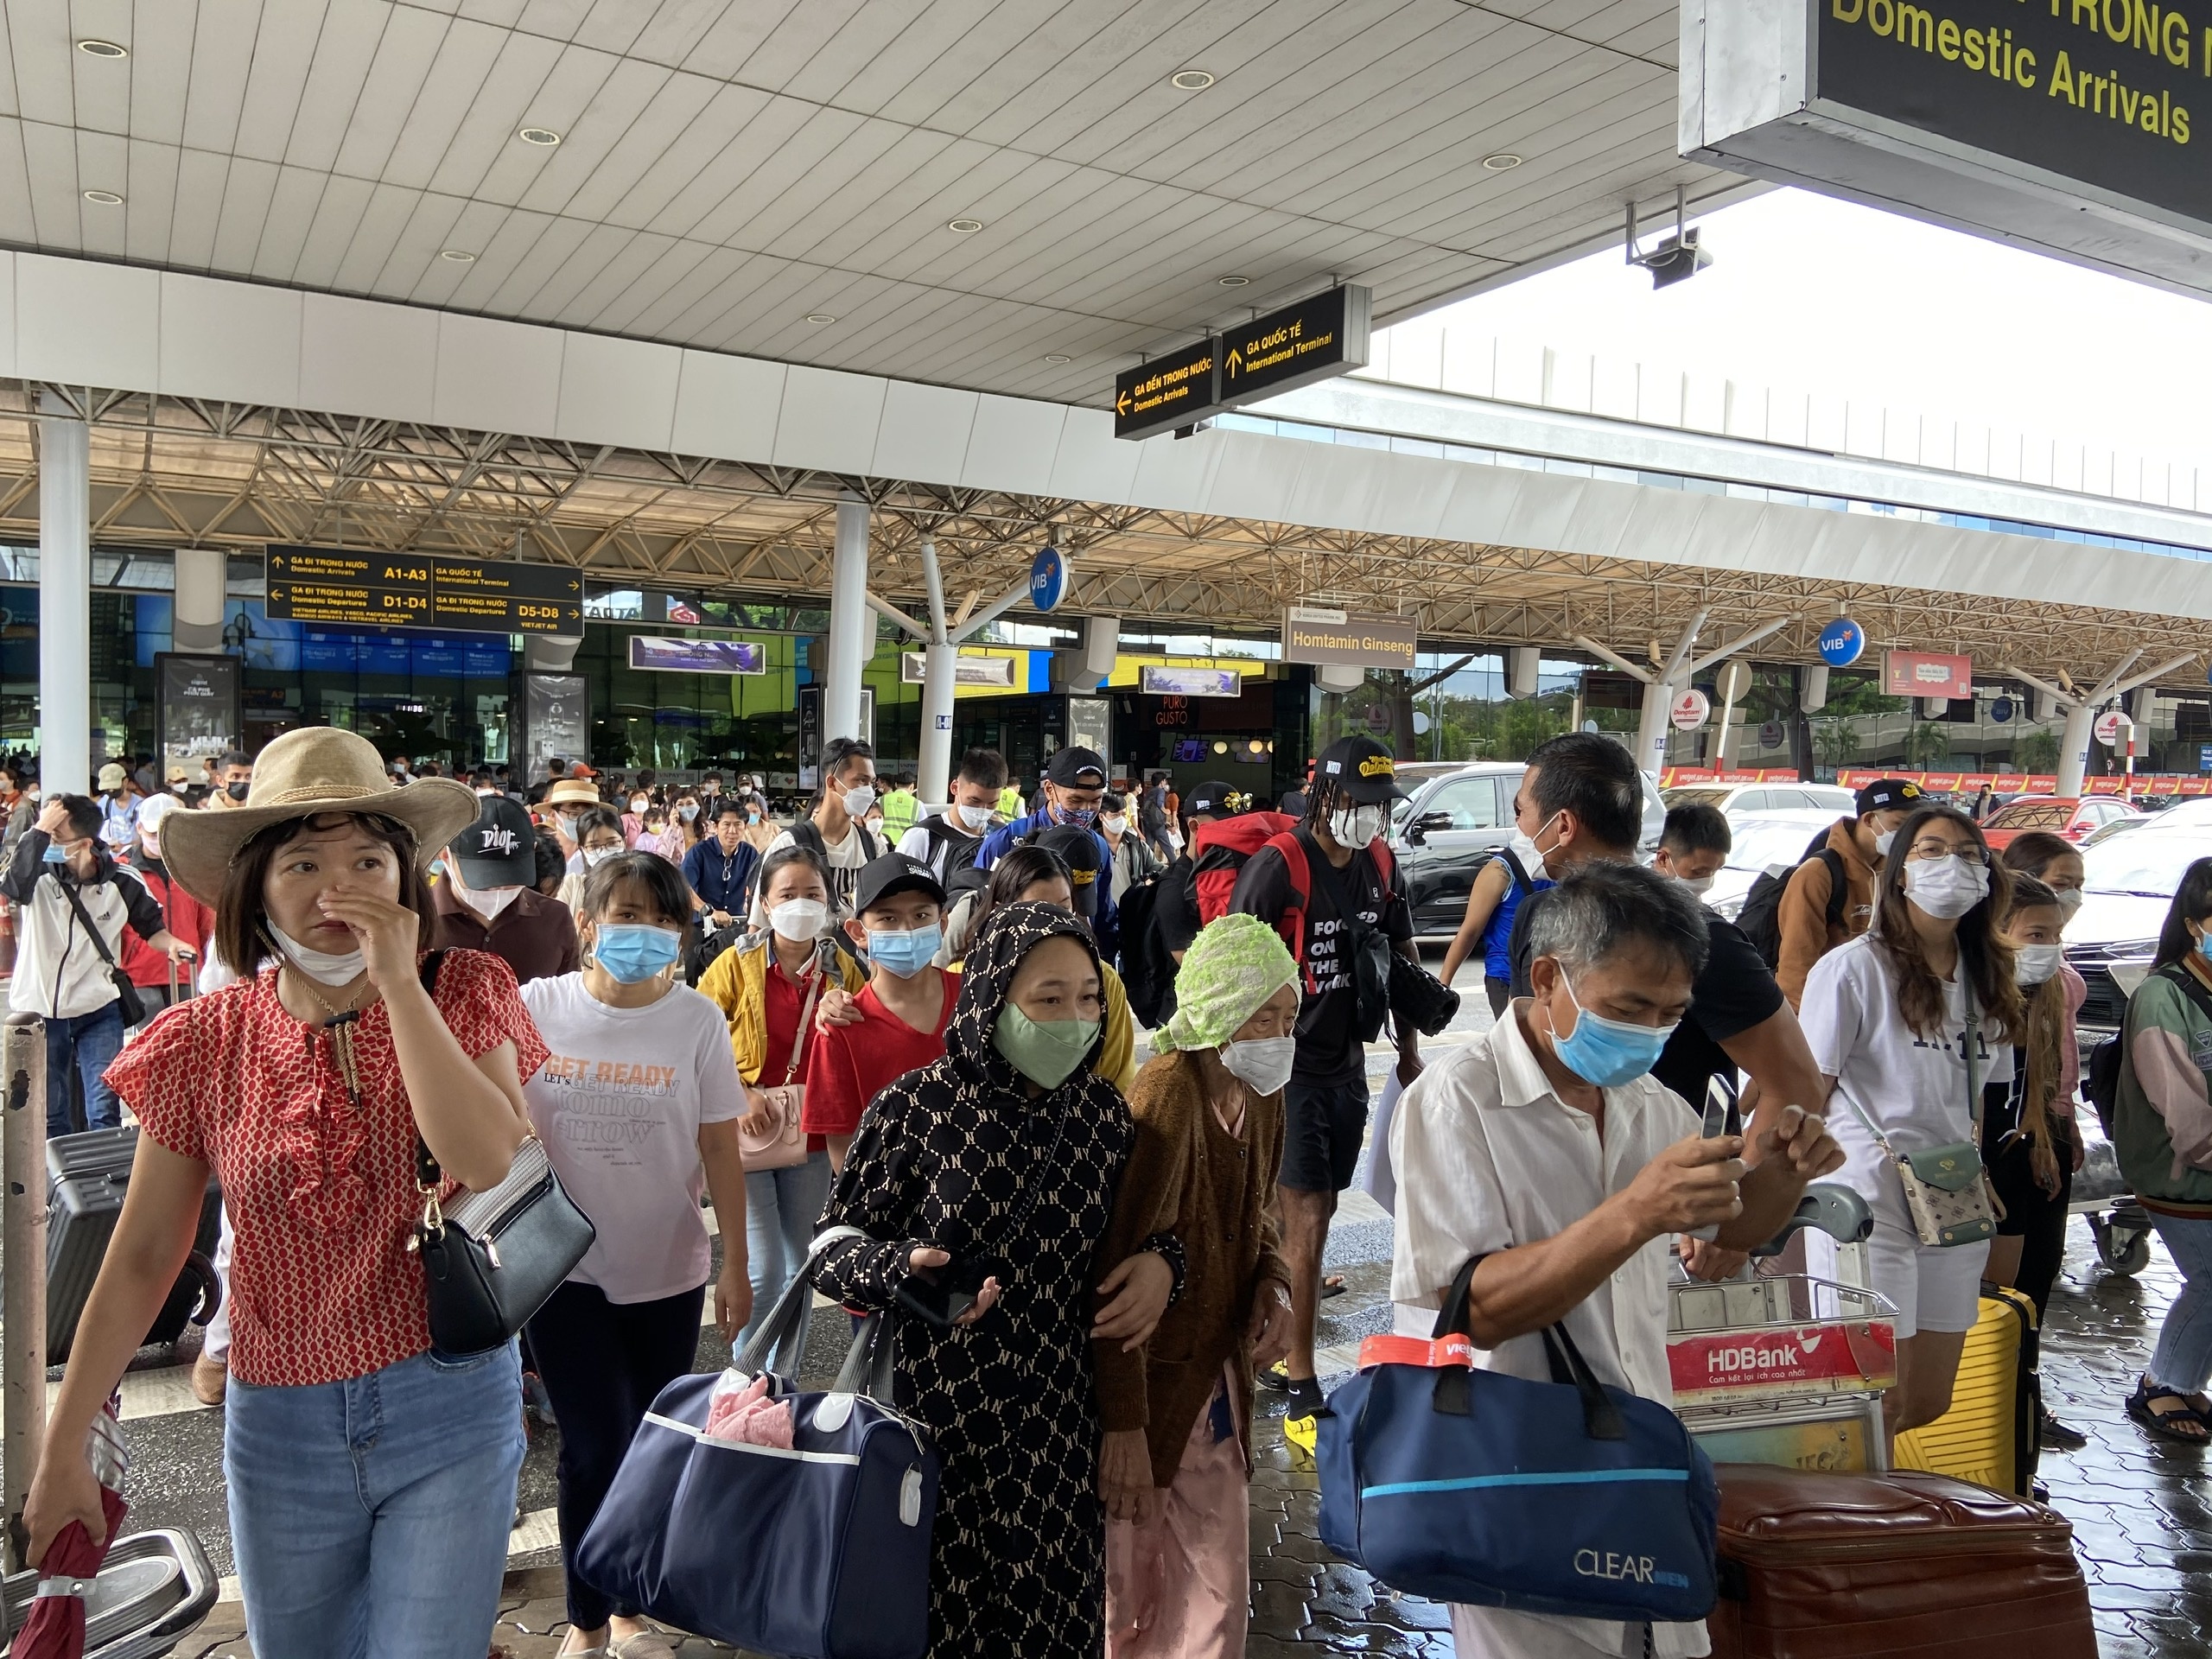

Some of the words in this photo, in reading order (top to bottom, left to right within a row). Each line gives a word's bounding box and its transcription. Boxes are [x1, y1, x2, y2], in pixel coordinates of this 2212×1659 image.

[1833, 0, 2037, 88] Domestic
[2048, 50, 2190, 144] Arrivals
[1247, 341, 1259, 355] GA
[1262, 327, 1287, 350] QUỐC
[1289, 319, 1302, 338] TẾ
[1246, 347, 1294, 373] International
[1295, 332, 1332, 355] Terminal
[1135, 384, 1145, 397] GA
[1146, 373, 1162, 393] ĐẾN
[1162, 369, 1189, 389] TRONG
[1134, 393, 1163, 412] Domestic
[1164, 385, 1189, 403] Arrivals
[290, 556, 302, 564] GA
[315, 558, 344, 568] TRONG
[290, 565, 326, 575] Domestic
[327, 568, 356, 576] Arrivals
[385, 567, 427, 581] A1-A3
[436, 576, 479, 585] International
[480, 578, 509, 587] Terminal
[1031, 573, 1047, 590] VIB
[291, 586, 302, 594] GA
[315, 588, 344, 597] TRONG
[291, 595, 326, 605] Domestic
[327, 597, 367, 607] Departures
[384, 595, 428, 609] D1-D4
[436, 605, 468, 613] Domestic
[469, 607, 505, 615] Departures
[518, 606, 559, 618] D5-D8
[1294, 630, 1359, 651] Homtamin
[1362, 636, 1414, 657] Ginseng
[1821, 638, 1845, 652] VIB
[1163, 695, 1188, 709] PURO
[1155, 710, 1188, 725] GUSTO
[480, 823, 516, 855] Dior
[1311, 939, 1336, 957] ON
[1308, 958, 1338, 975] THE
[546, 1054, 589, 1079] GET
[596, 1061, 676, 1088] READY
[544, 1072, 570, 1085] LET's
[570, 1071, 607, 1092] GET
[613, 1076, 680, 1097] READY
[554, 1085, 651, 1118] tomo
[1708, 1344, 1798, 1372] HDBank
[1709, 1376, 1726, 1384] Cam
[1728, 1373, 1741, 1382] kết
[1744, 1372, 1754, 1382] lợi
[1789, 1369, 1806, 1377] nhất
[1573, 1548, 1654, 1584] CLEAR
